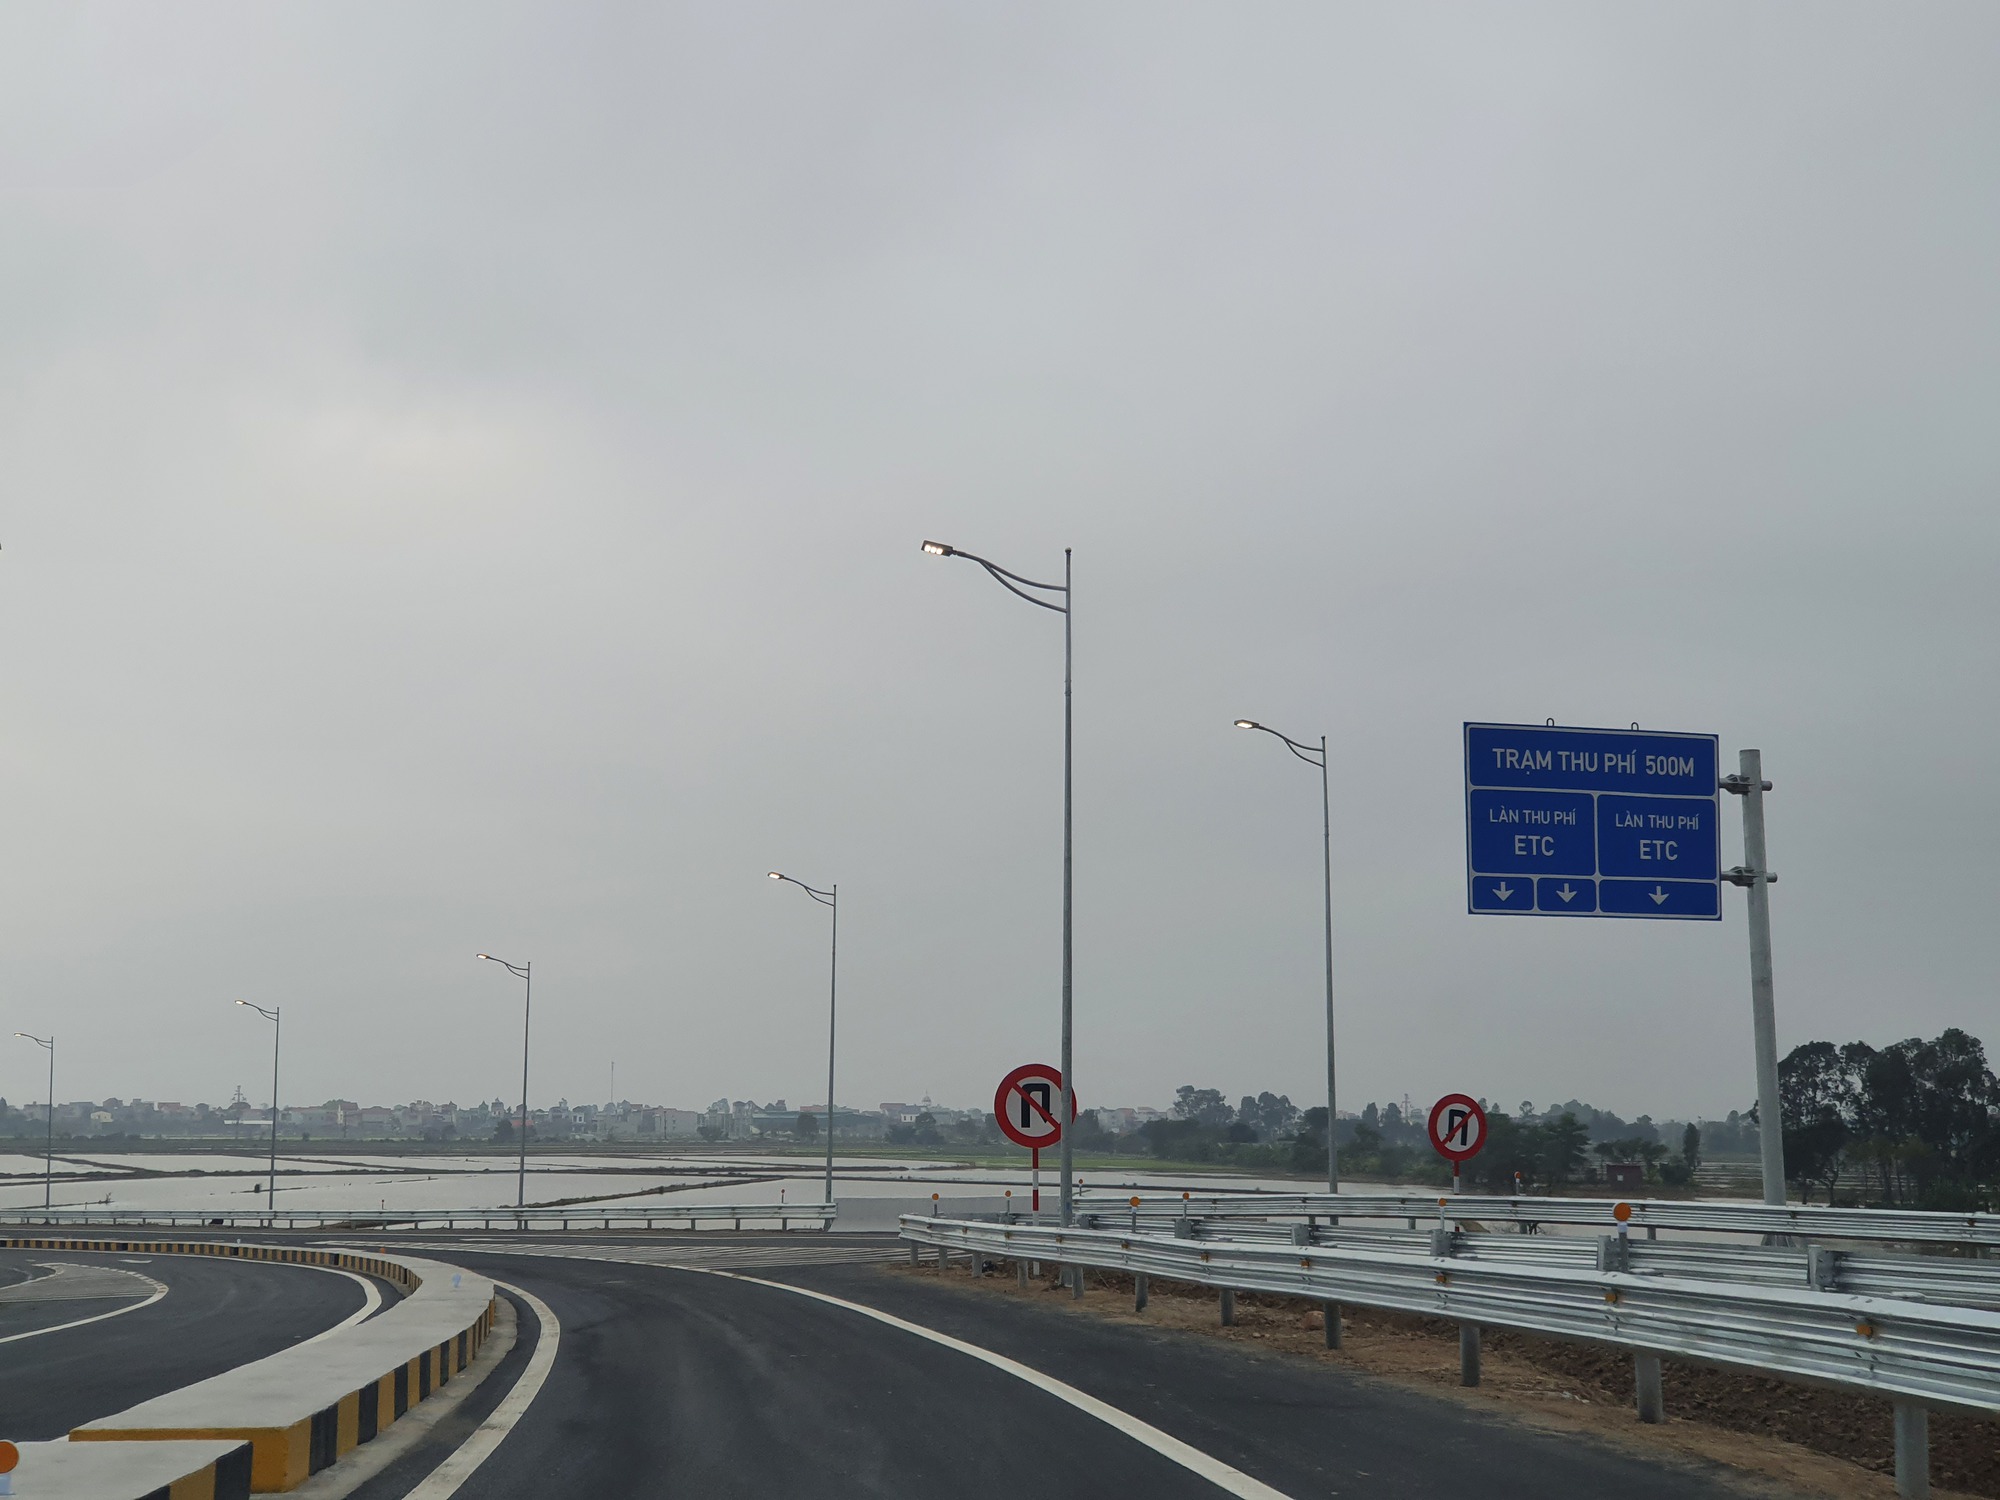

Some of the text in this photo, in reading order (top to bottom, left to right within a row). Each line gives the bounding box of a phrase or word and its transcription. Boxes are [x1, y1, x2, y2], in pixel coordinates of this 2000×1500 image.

[1492, 748, 1694, 777] TRẠM THU PHÍ 500M
[1489, 806, 1576, 825] LÀN THU PHÍ
[1615, 811, 1699, 830] LÀN THU PHÍ
[1514, 835, 1554, 856] ETC
[1639, 840, 1678, 861] ETC
